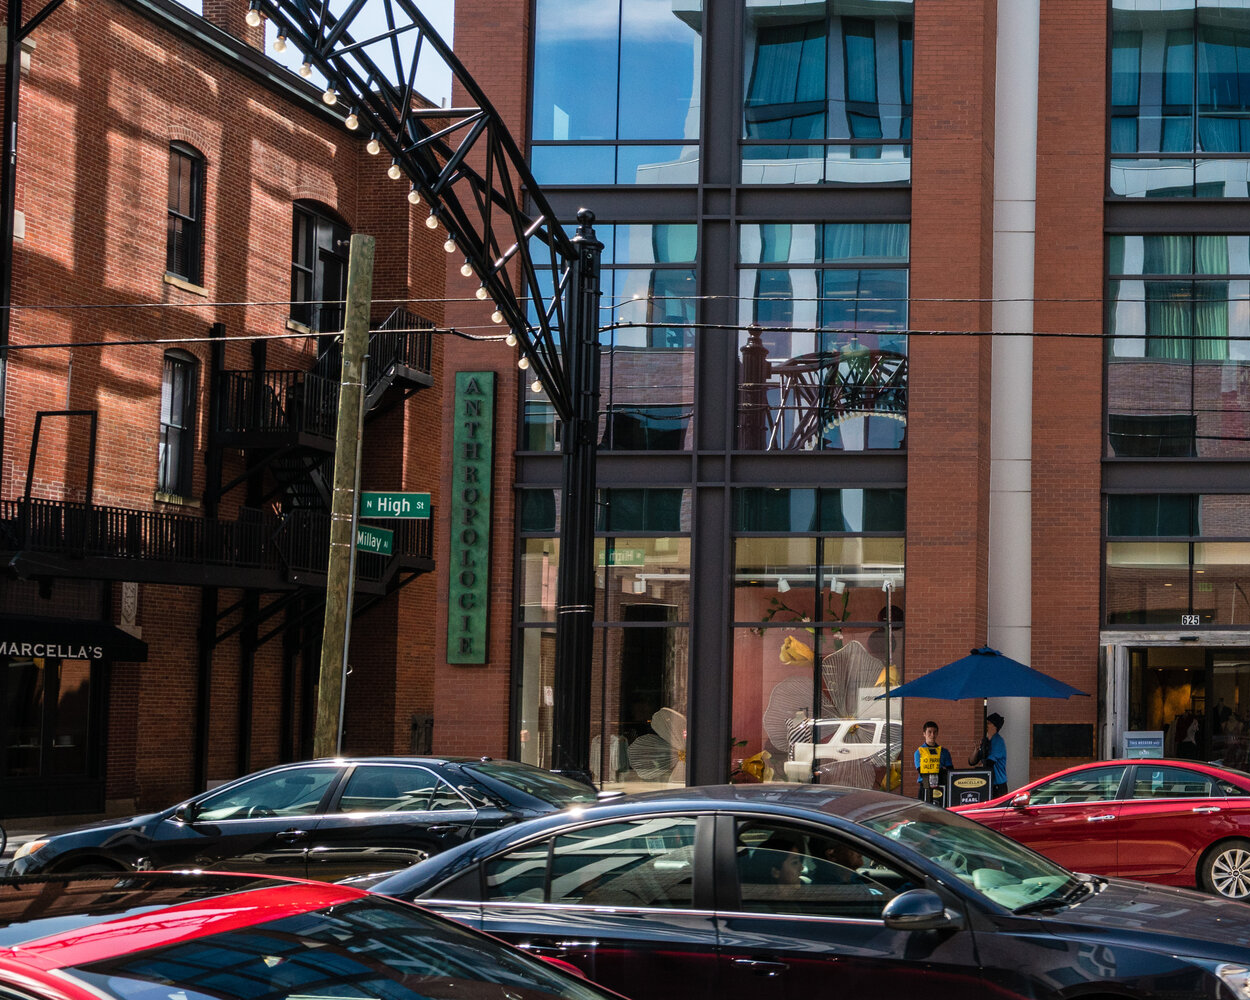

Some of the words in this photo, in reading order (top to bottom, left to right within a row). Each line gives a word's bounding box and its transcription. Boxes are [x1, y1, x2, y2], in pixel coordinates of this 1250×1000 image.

[366, 500, 373, 509] N
[377, 497, 411, 516] High
[416, 501, 425, 510] St
[458, 376, 483, 655] ANTHROPOLOGIE
[357, 530, 382, 552] Millay
[1182, 615, 1199, 625] 625
[0, 641, 103, 659] MARCELLA'S
